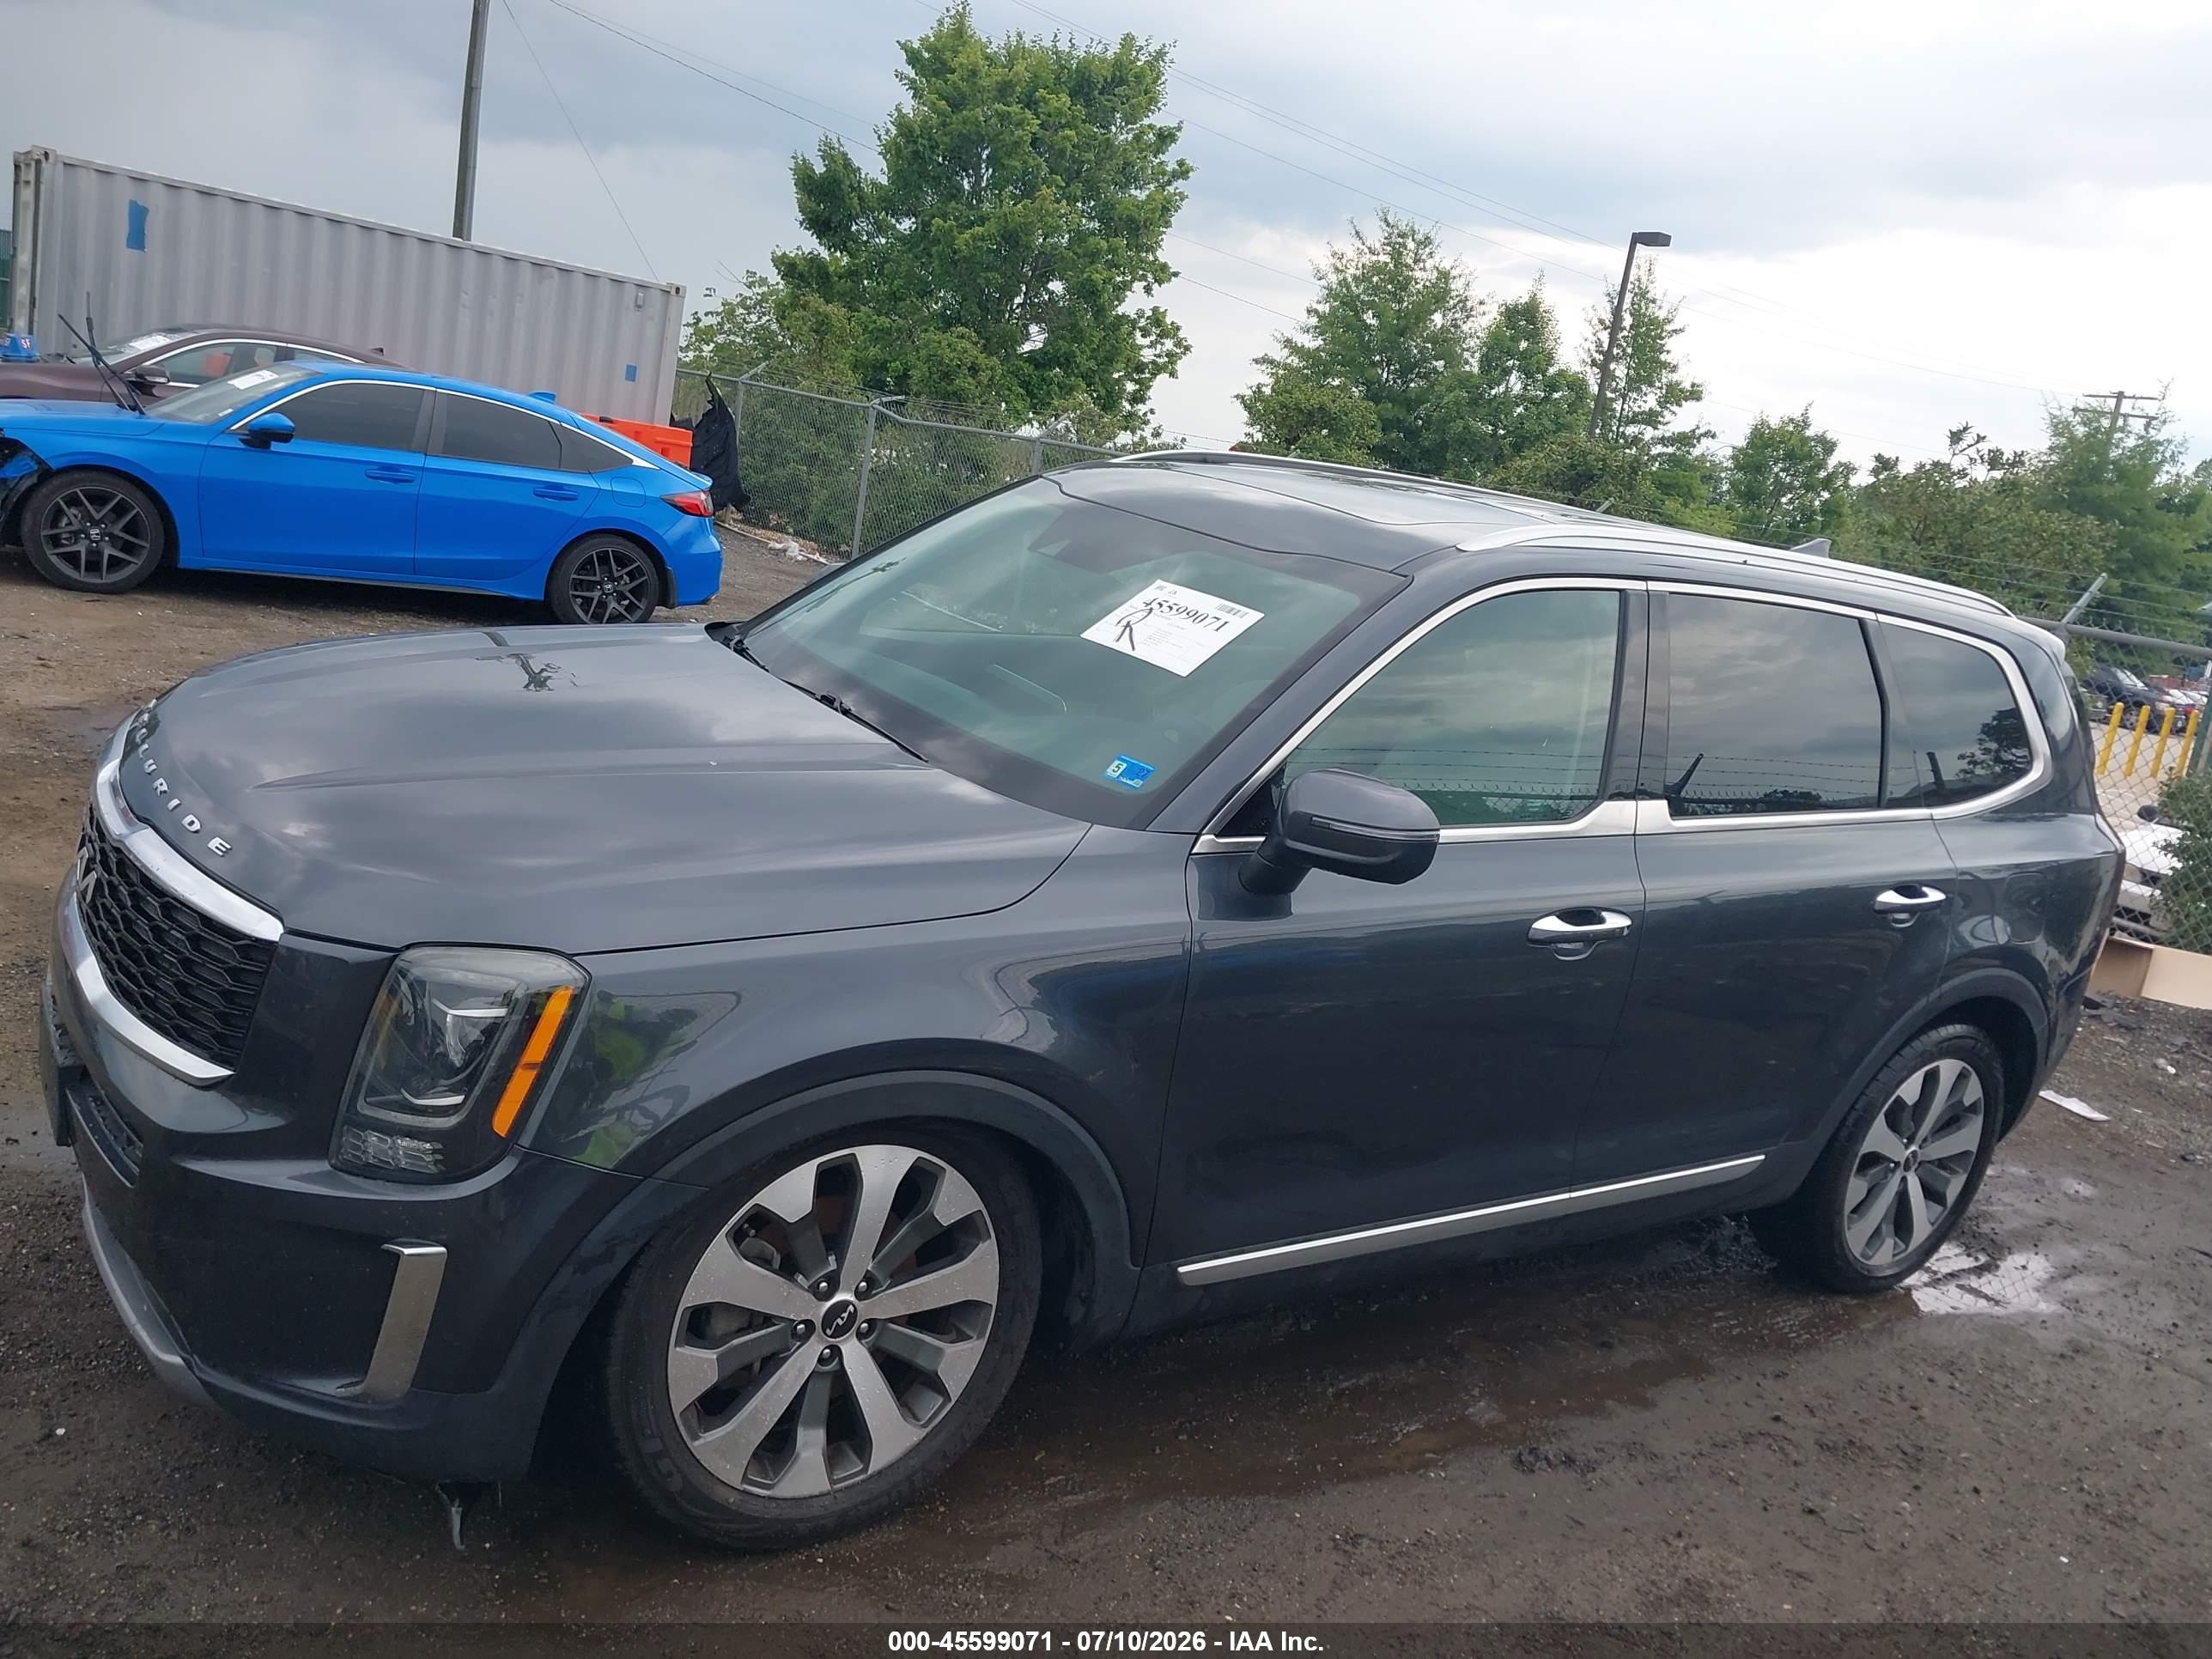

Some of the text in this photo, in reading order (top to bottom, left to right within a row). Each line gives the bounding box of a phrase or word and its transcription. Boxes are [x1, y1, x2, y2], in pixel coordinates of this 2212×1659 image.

[1143, 597, 1231, 632] 45599071
[135, 704, 232, 857] LLURIDE
[1112, 763, 1123, 773] 5
